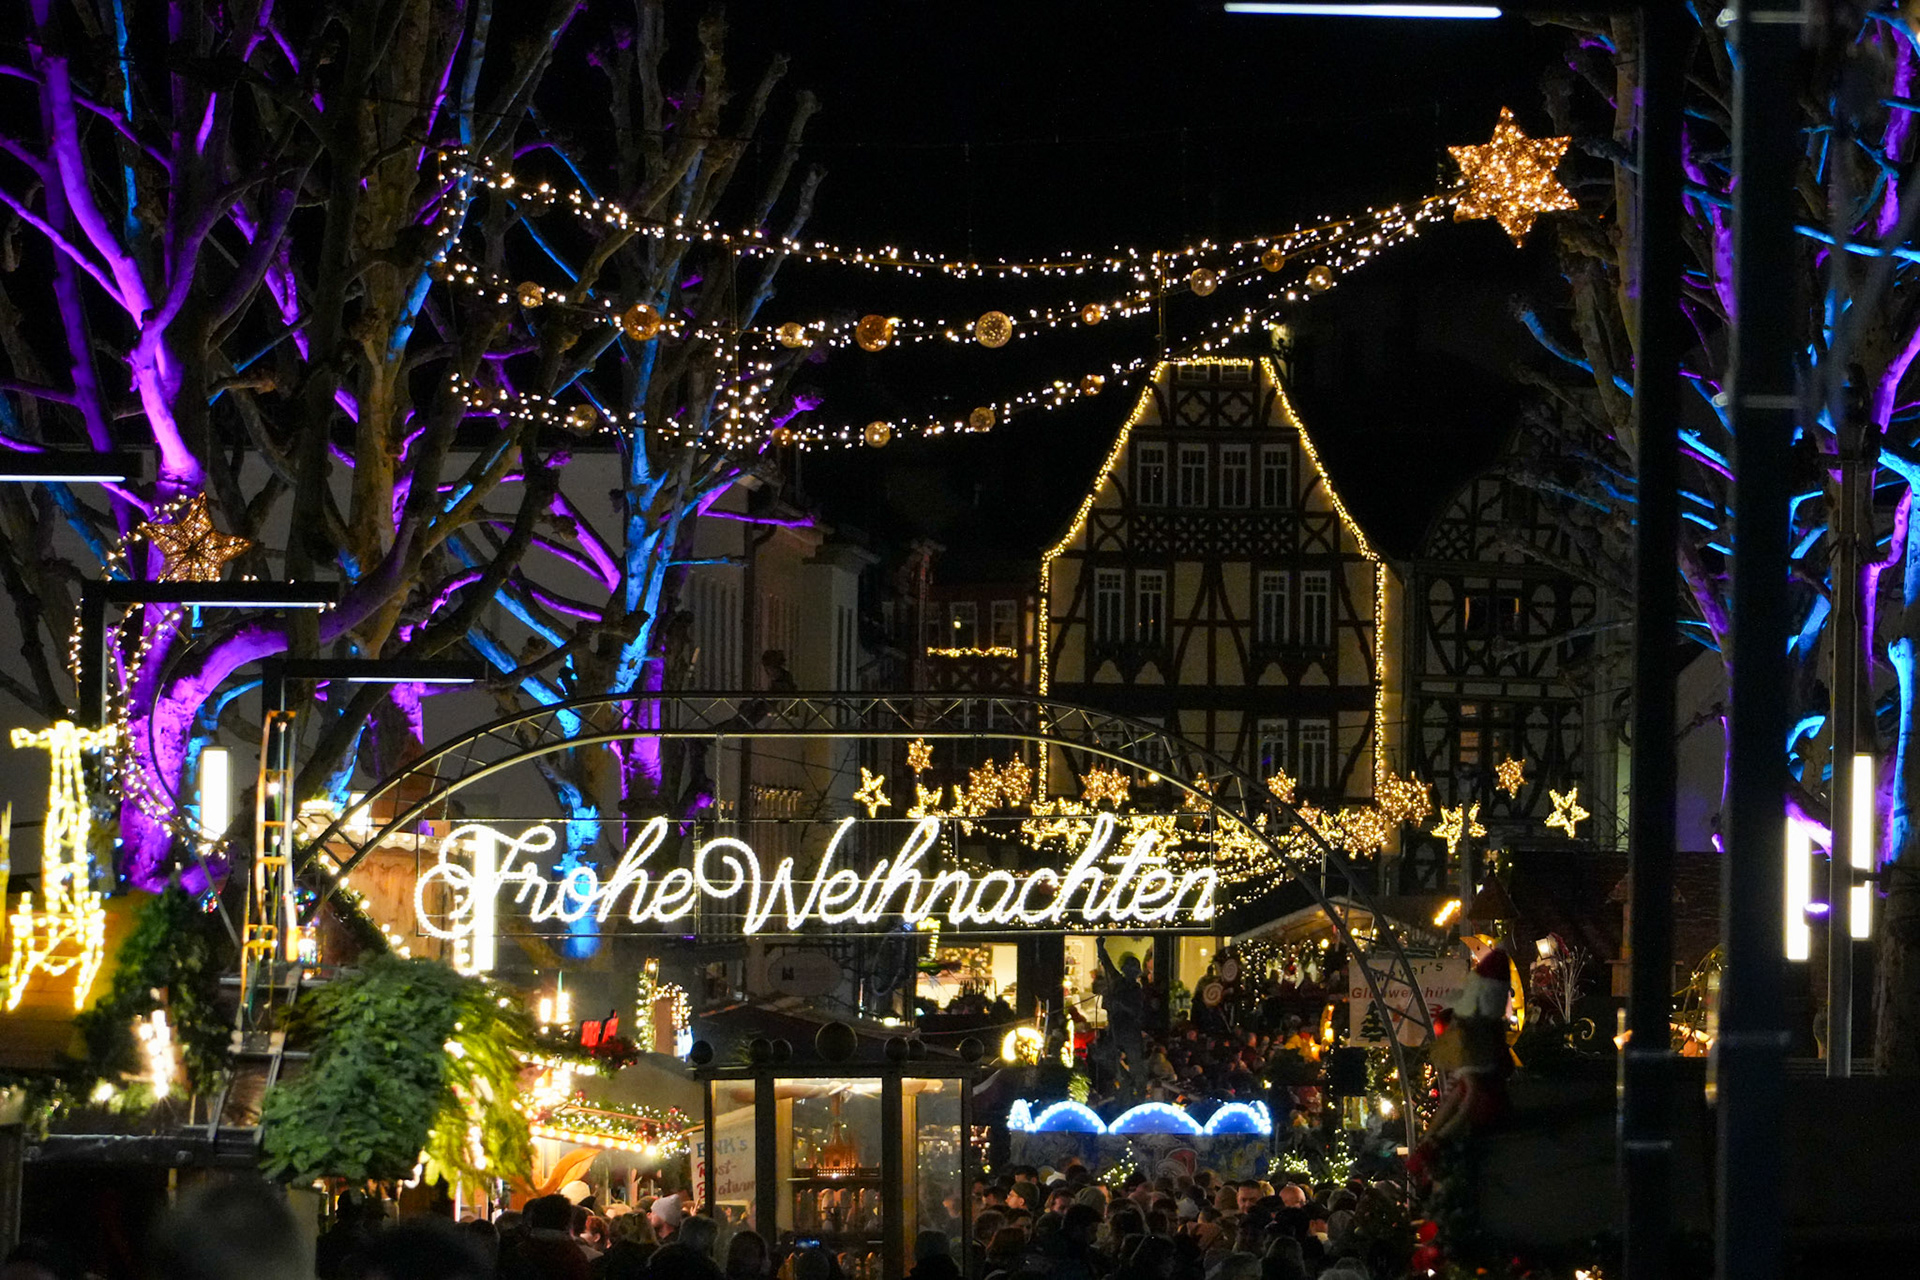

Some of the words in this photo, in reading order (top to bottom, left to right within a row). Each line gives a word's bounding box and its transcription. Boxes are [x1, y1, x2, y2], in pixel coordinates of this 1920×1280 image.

[414, 815, 697, 939] Frohe
[699, 812, 1216, 935] Weihnachten
[697, 1160, 737, 1178] Rst-
